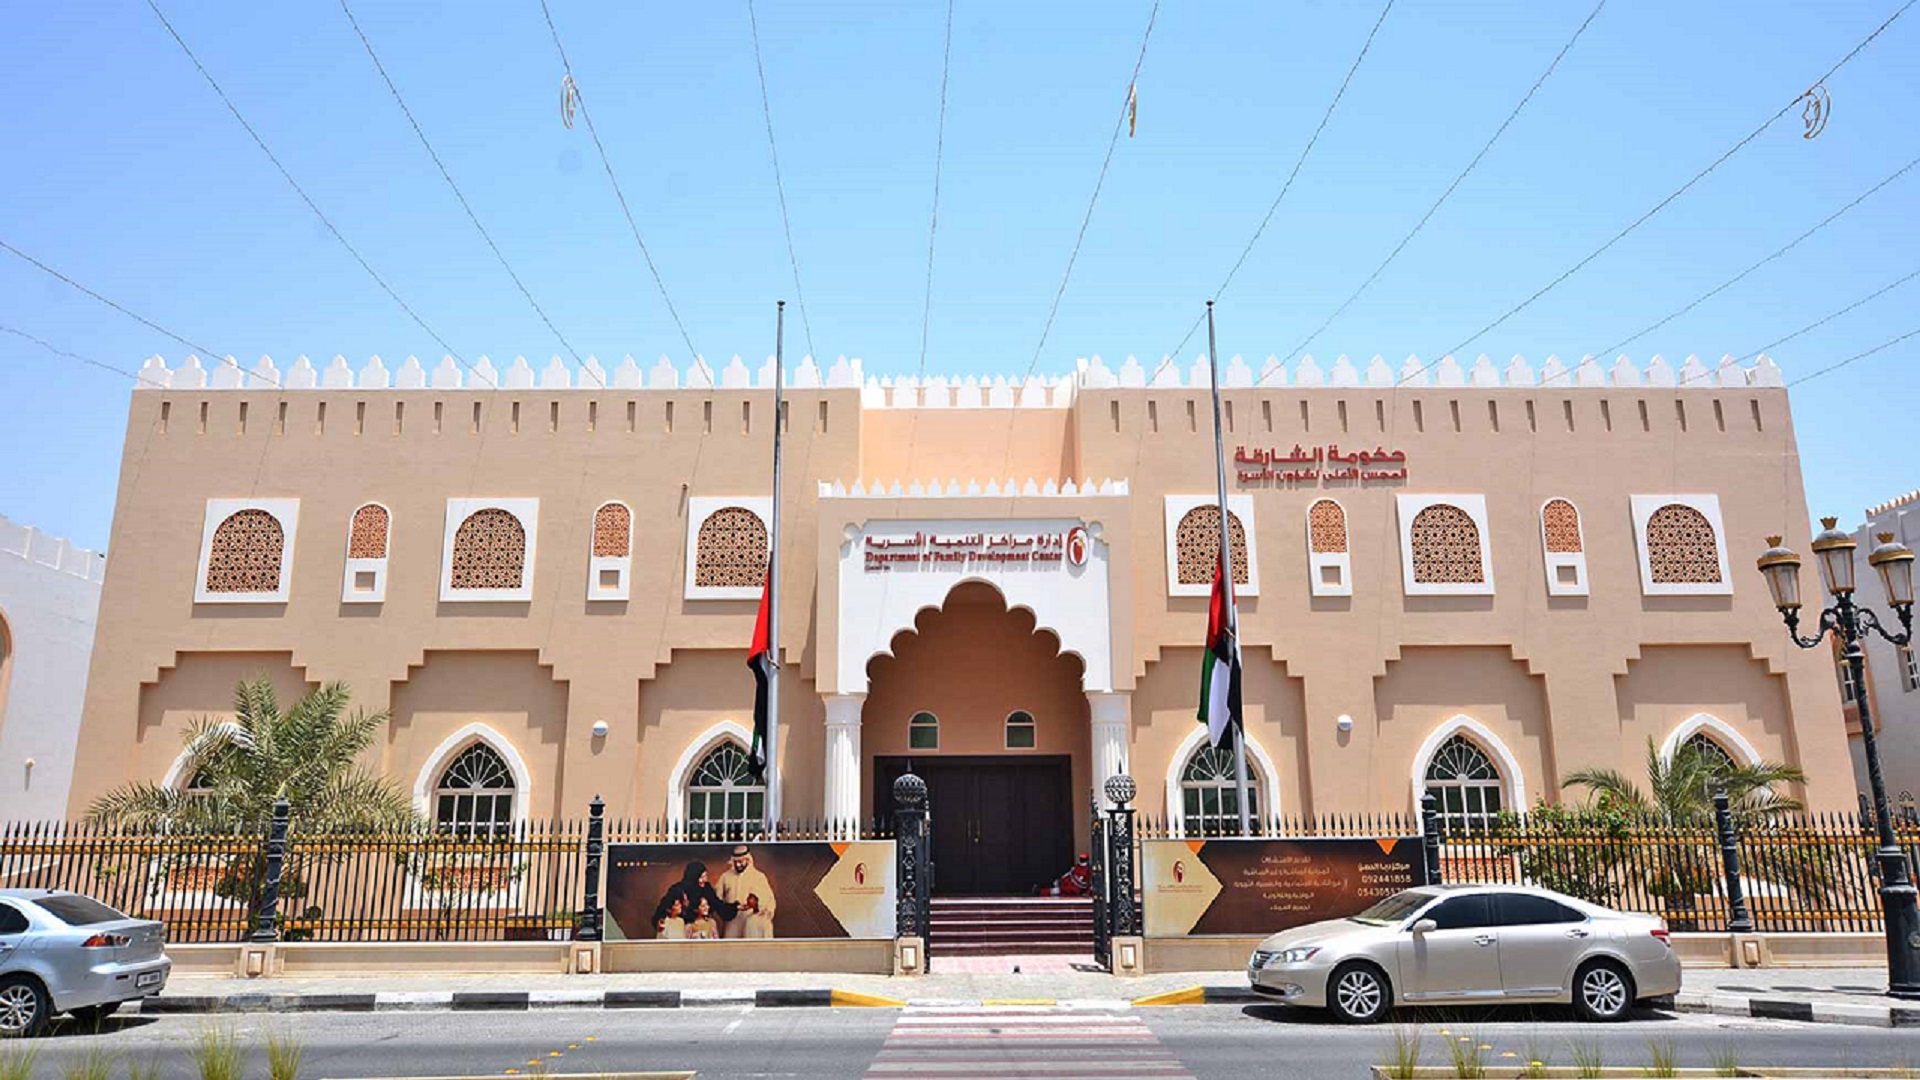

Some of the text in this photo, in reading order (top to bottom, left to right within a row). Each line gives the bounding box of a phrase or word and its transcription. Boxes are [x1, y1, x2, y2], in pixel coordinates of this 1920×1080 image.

[1234, 444, 1406, 466] حكومة الشارقة
[1237, 468, 1274, 483] الأسرة
[1276, 467, 1319, 481] لشؤون
[1322, 467, 1359, 481] الأعلى
[865, 531, 1062, 549] إدارة مراكز التنمية الأسرية
[865, 551, 920, 563] Department
[923, 551, 932, 561] of
[934, 551, 967, 564] Family
[968, 551, 1030, 563] Development
[1392, 862, 1411, 871] مركز
[1361, 875, 1412, 883] 092441858
